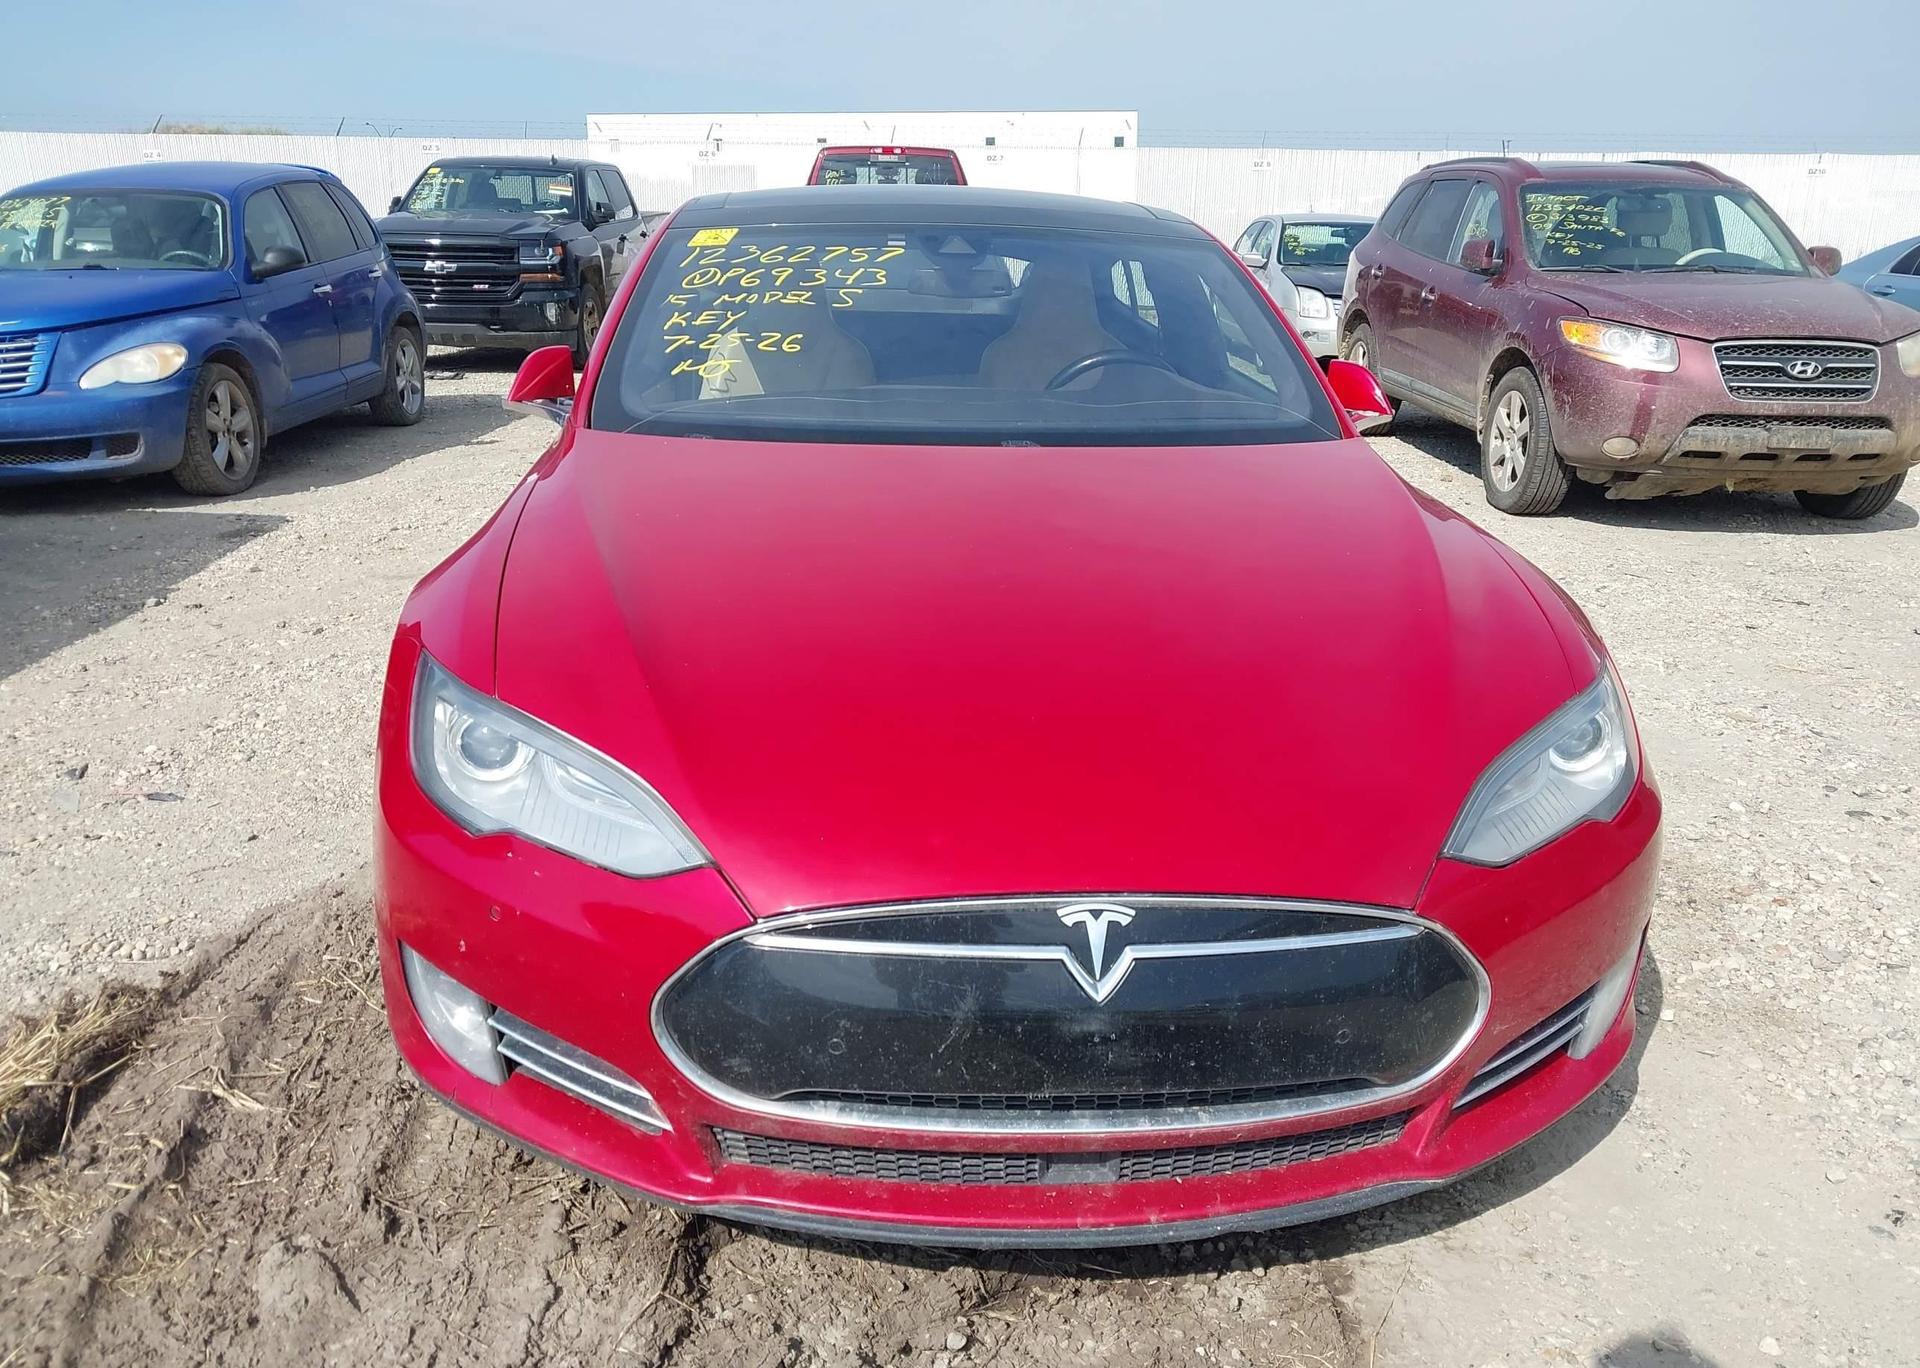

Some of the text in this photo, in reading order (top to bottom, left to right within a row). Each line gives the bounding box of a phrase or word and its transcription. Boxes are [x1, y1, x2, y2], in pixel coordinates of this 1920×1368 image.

[1525, 193, 1590, 203] INTACT
[679, 245, 905, 268] 12362757
[713, 291, 816, 306] MODEL
[831, 288, 864, 308] S
[663, 310, 748, 332] KEY
